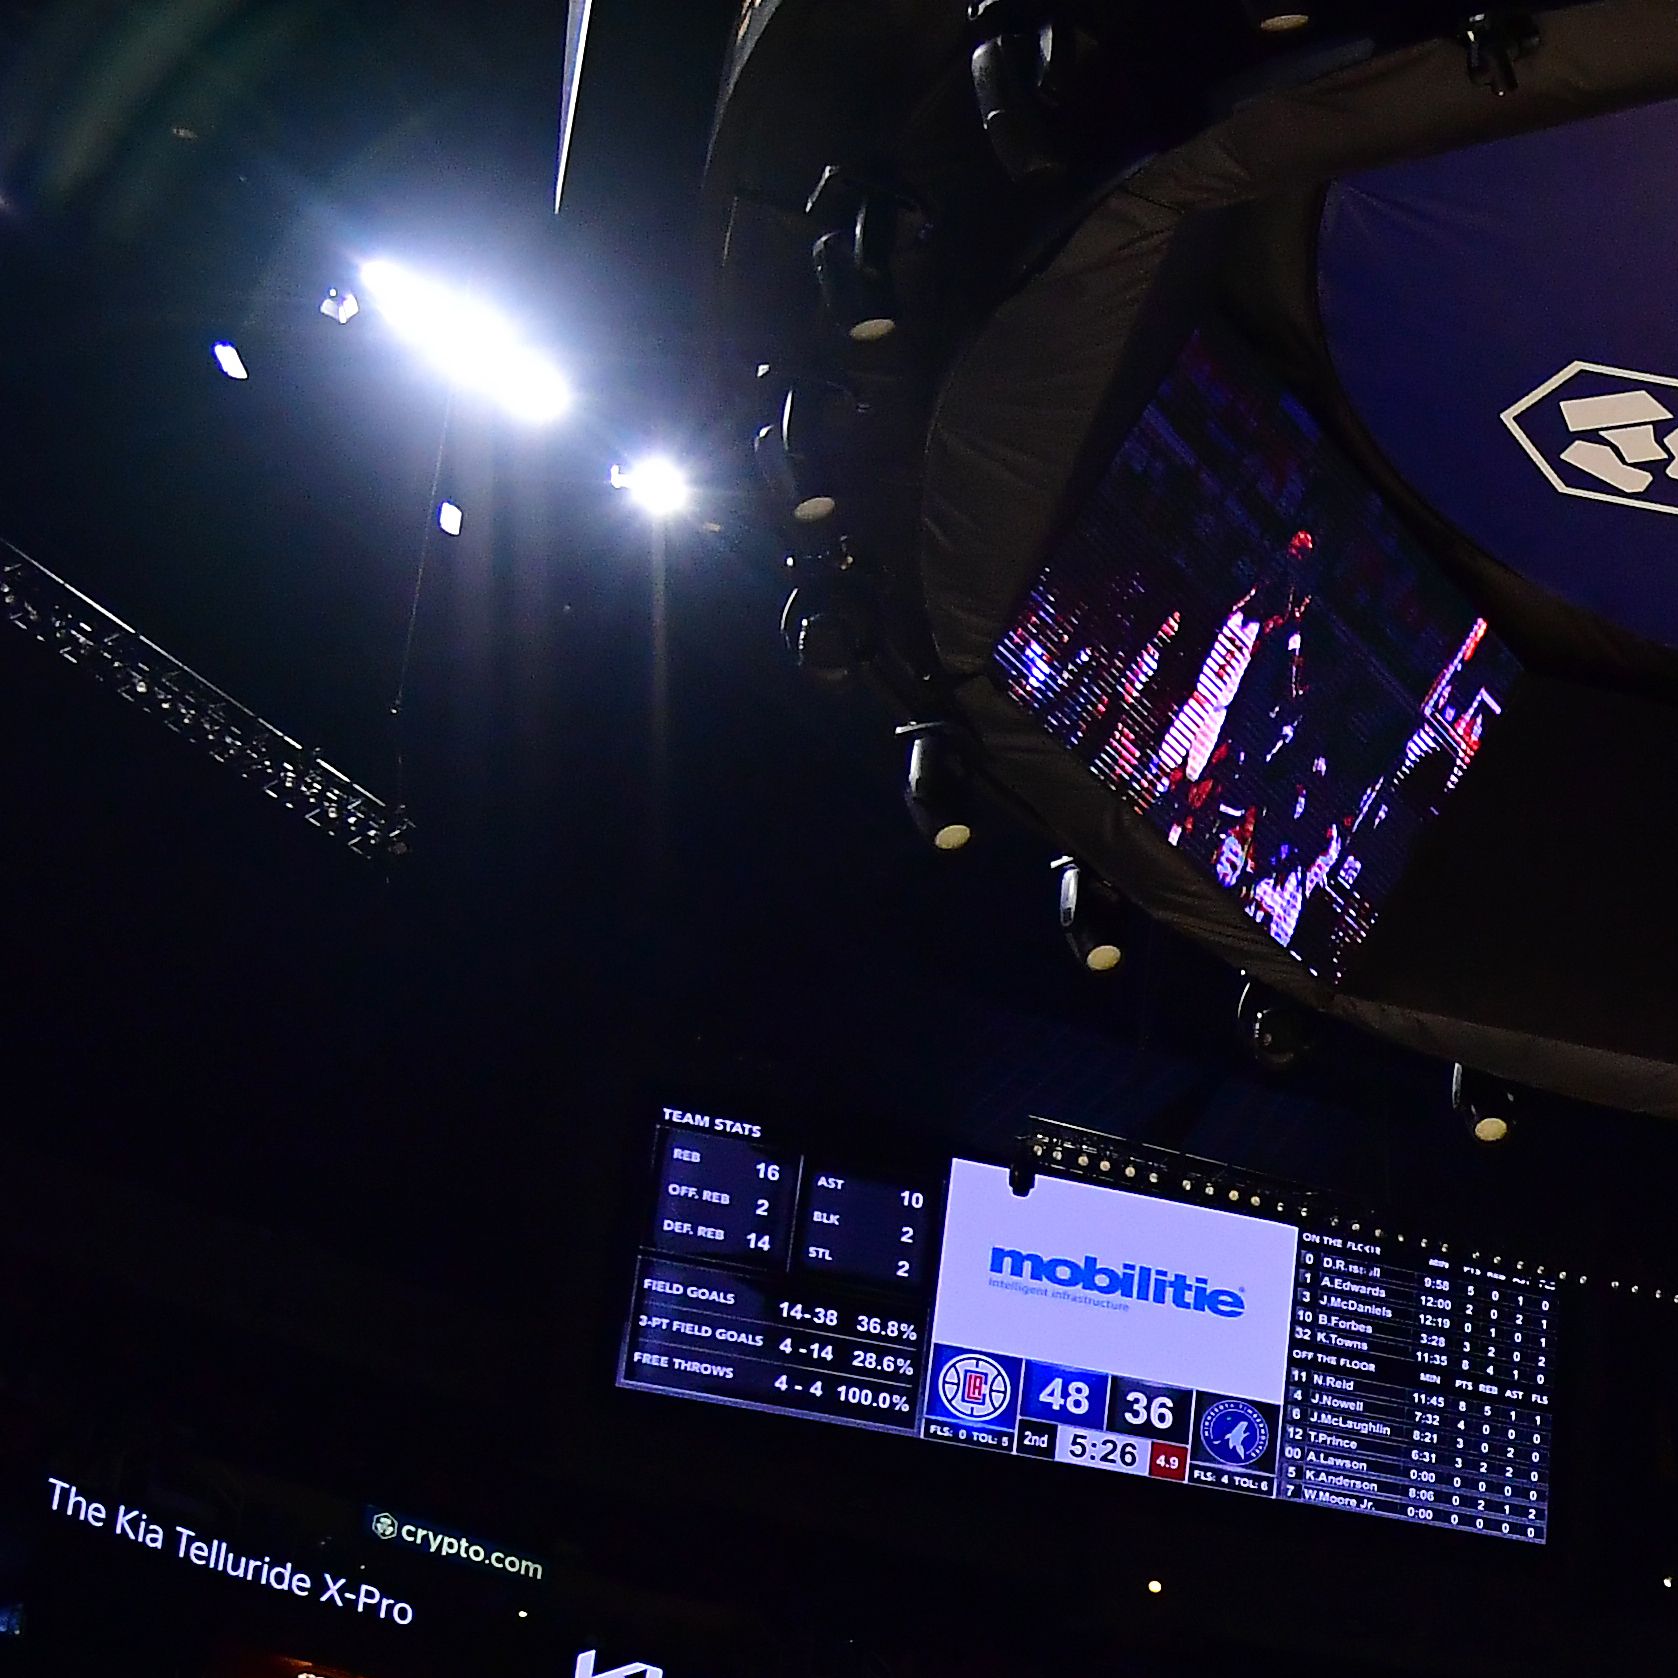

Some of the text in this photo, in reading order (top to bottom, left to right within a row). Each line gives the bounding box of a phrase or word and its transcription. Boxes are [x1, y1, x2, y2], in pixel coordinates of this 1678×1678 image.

[663, 1108, 761, 1138] TEAM STATS
[673, 1148, 780, 1181] REB 16
[989, 1246, 1245, 1318] mobilitie
[1320, 1276, 1386, 1298] A.Edwards
[643, 1278, 918, 1341] FIELD GOALS 14-38 36.8%
[671, 1320, 713, 1337] FIELD
[715, 1328, 764, 1347] GOALS
[852, 1350, 914, 1376] 28.6%
[633, 1351, 910, 1412] FREE THROWS 100.0%
[1039, 1378, 1173, 1429] 48 36
[1023, 1430, 1179, 1470] 2nd 5:26 4.9
[48, 1478, 412, 1624] The Kia Telluride X-Pro
[402, 1525, 542, 1579] crypto.com
